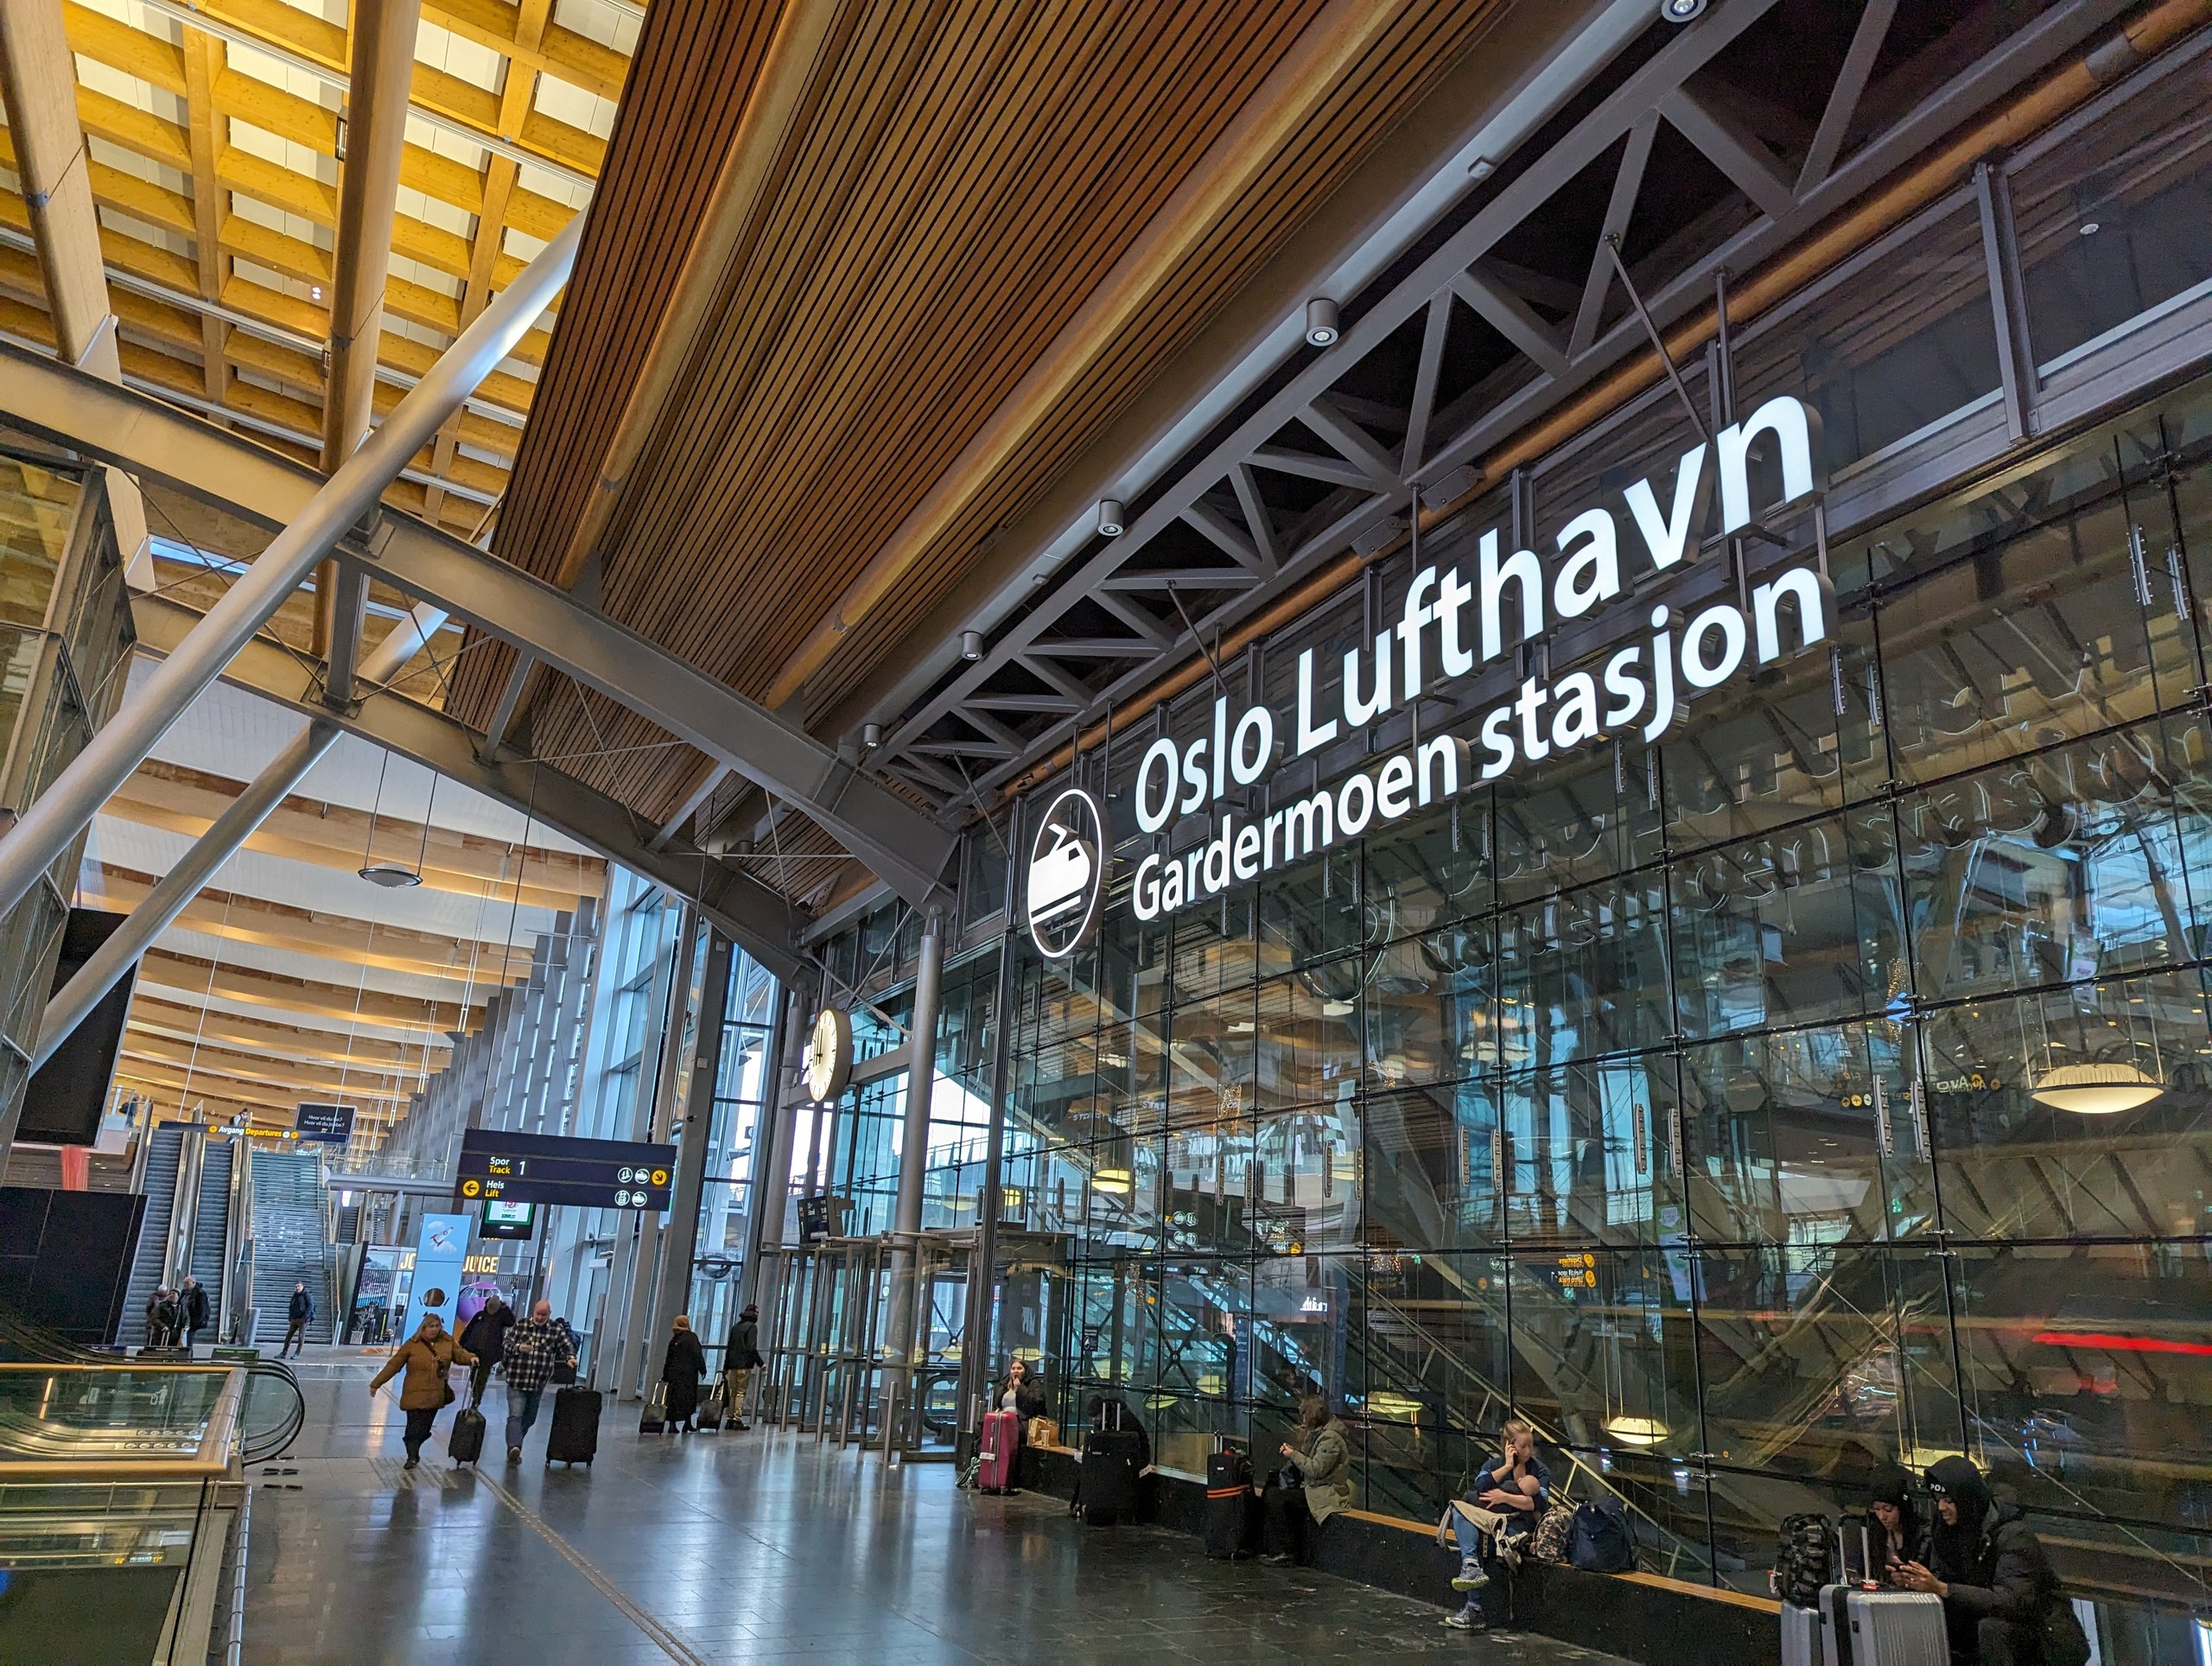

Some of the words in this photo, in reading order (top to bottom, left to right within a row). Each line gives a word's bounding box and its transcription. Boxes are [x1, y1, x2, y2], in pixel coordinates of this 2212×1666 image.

[1135, 696, 1274, 833] Oslo
[1297, 397, 1812, 757] Lufthavn
[1132, 734, 1458, 921] Gardermoen
[1481, 567, 1825, 779] stasjon
[219, 1126, 245, 1135] Avgang
[245, 1128, 283, 1137] Departures
[489, 1165, 511, 1174] Track
[490, 1156, 510, 1167] Spor
[519, 1160, 526, 1175] 1
[486, 1180, 505, 1189] Heis
[485, 1189, 499, 1198] Lift
[462, 1256, 499, 1274] JUICE
